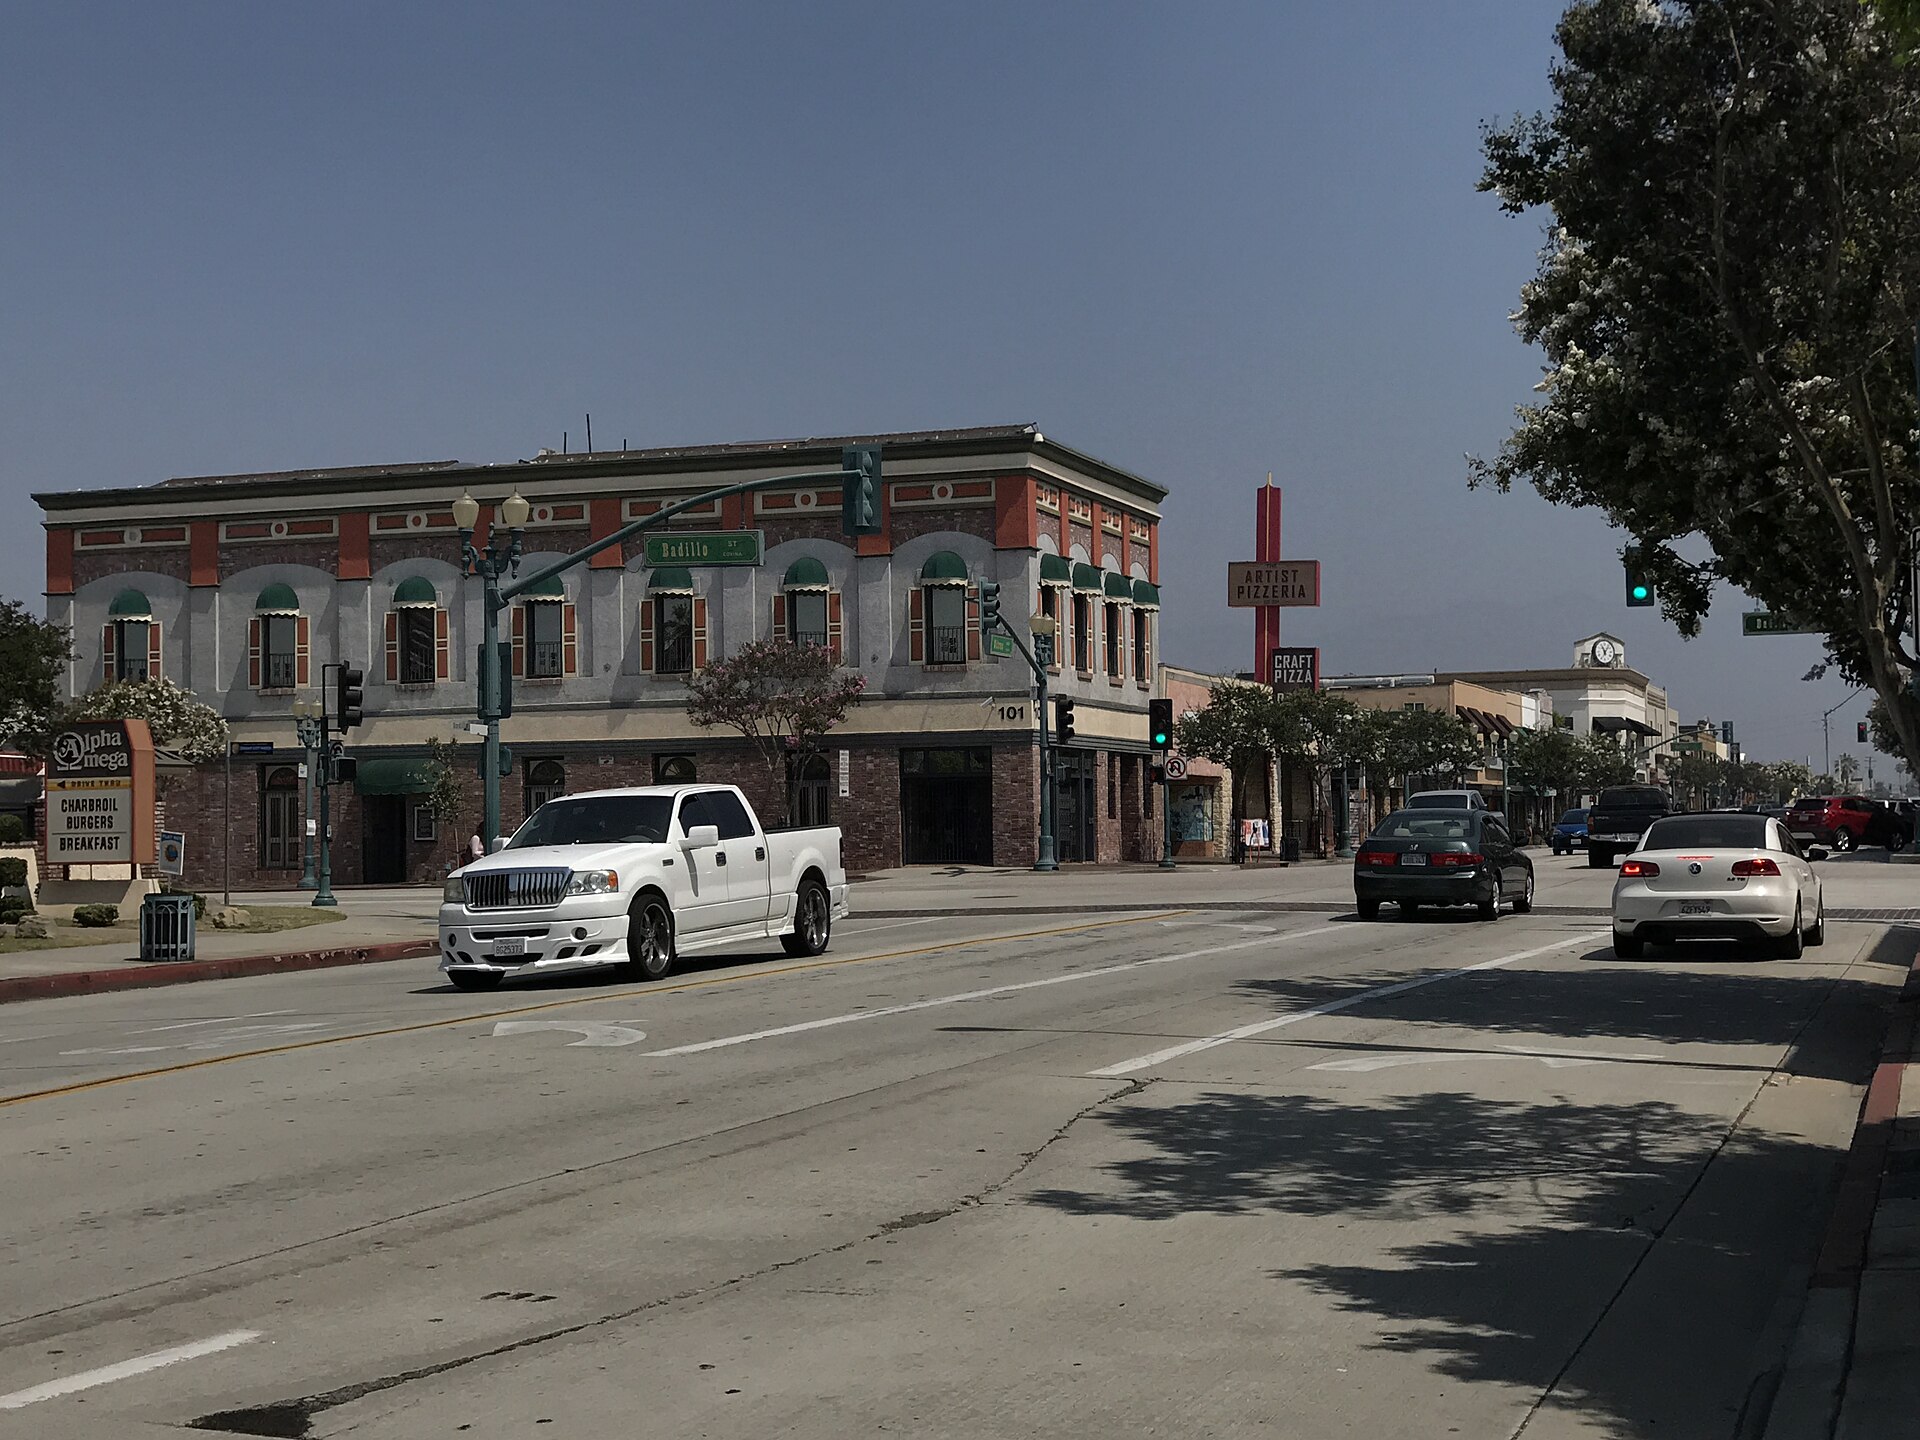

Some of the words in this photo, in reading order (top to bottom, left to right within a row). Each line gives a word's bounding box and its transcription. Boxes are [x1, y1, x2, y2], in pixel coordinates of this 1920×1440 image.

[661, 541, 708, 558] Badillo
[1245, 569, 1299, 584] ARTIST
[1237, 585, 1306, 599] PIZZERIA
[1274, 654, 1313, 669] CRAFT
[1274, 669, 1313, 684] PIZZA
[998, 706, 1024, 720] 101
[70, 780, 95, 788] DRIVE
[61, 798, 118, 813] CHARBROIL
[66, 815, 114, 830] BURGERS
[59, 836, 120, 851] BREAKFAST
